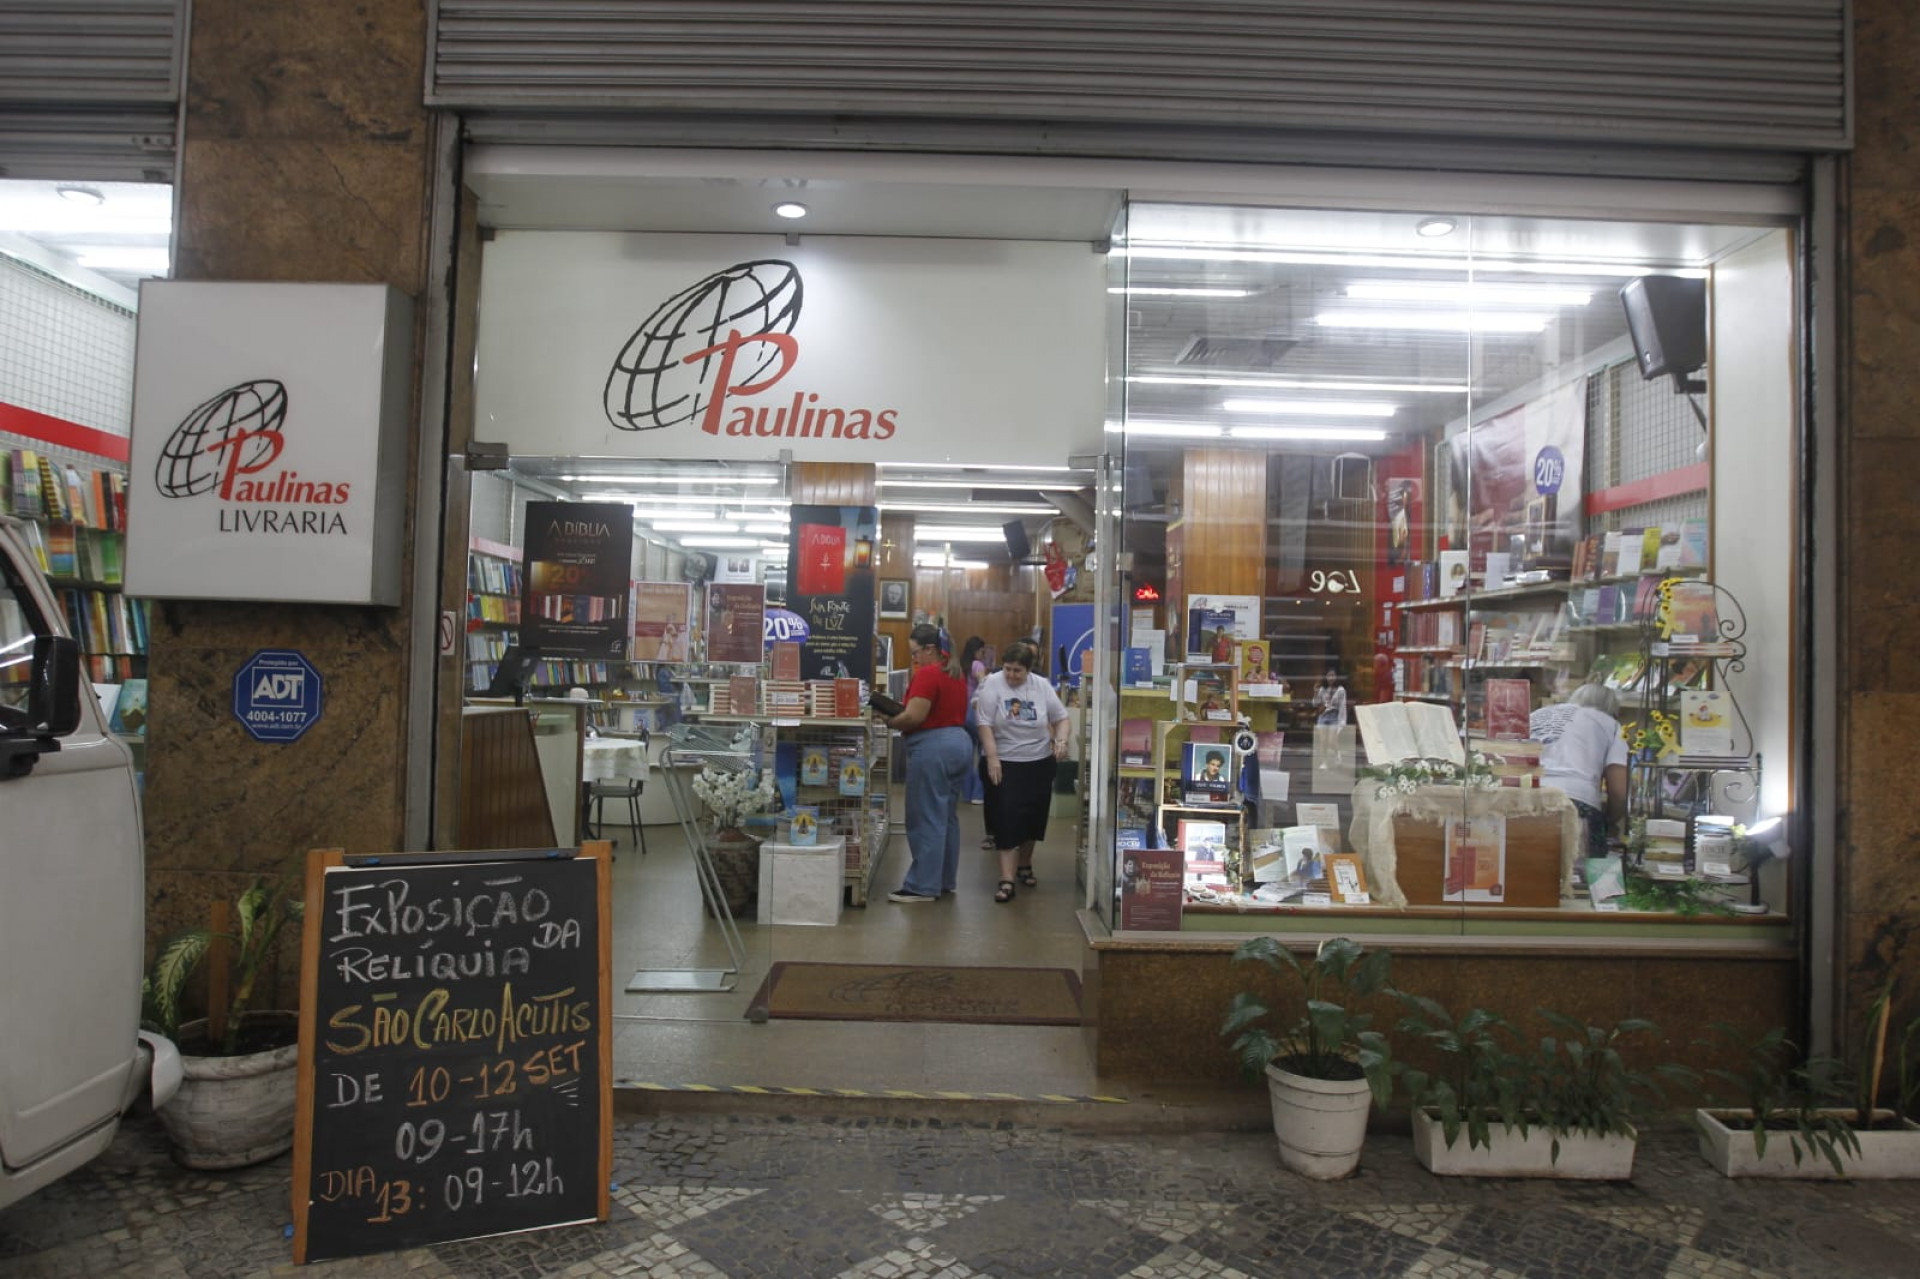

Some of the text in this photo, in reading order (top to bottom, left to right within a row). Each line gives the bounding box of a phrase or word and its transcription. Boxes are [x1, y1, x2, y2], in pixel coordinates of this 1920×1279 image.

[683, 329, 898, 440] Paulinas
[208, 427, 351, 505] Paulinas
[219, 509, 348, 535] LIVRARIA
[252, 673, 304, 700] ADT
[246, 710, 307, 723] 4004-1077
[532, 919, 581, 949] DA
[325, 992, 409, 1055] SÃO
[497, 982, 592, 1053] ACUTIS
[327, 1072, 384, 1108] DE
[522, 1040, 587, 1085] SET
[319, 1165, 376, 1202] DIA
